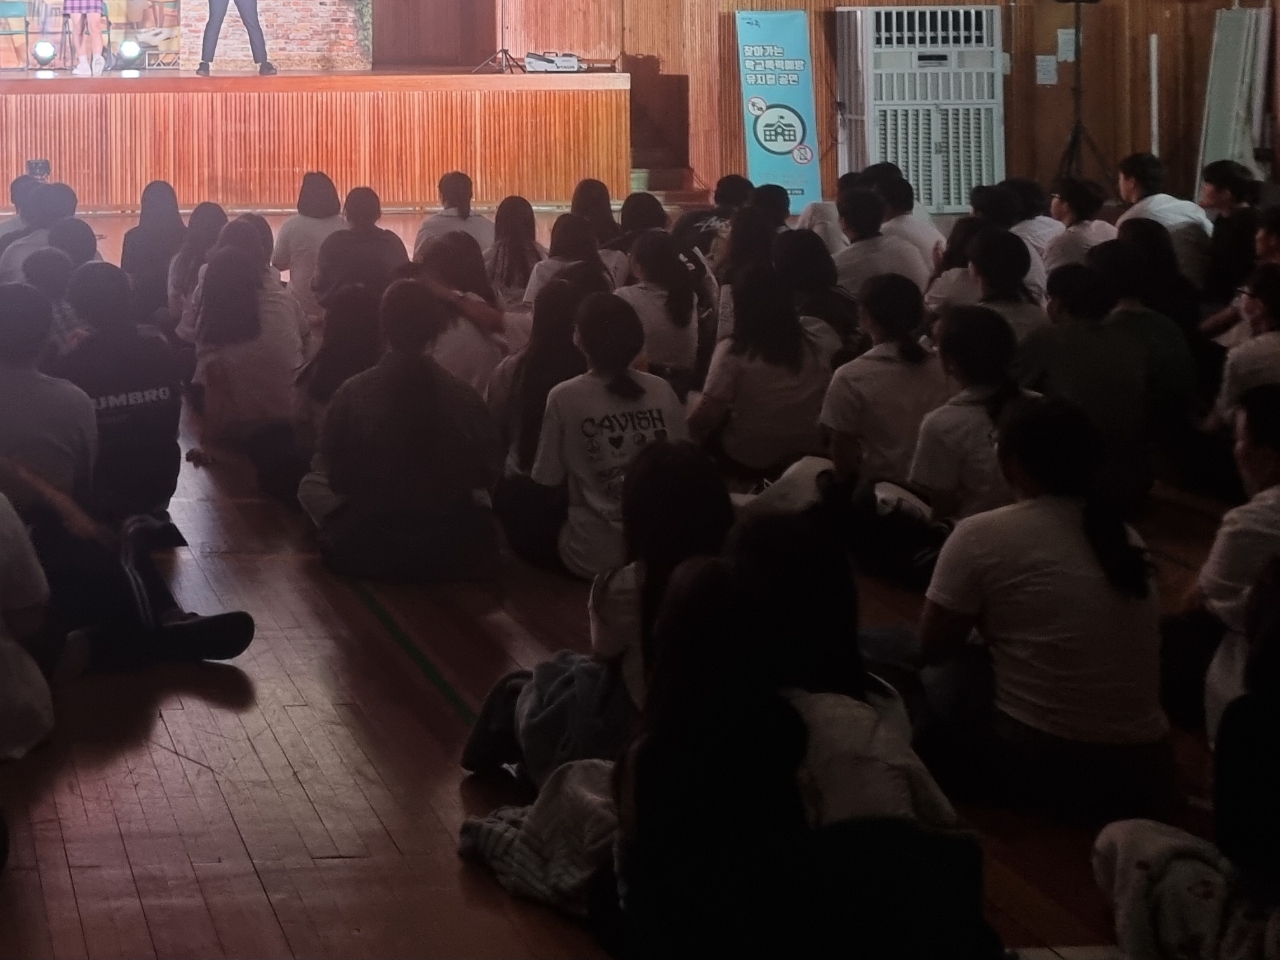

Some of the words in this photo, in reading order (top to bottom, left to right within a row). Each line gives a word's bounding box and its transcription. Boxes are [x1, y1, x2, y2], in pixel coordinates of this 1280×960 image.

[743, 45, 784, 57] 찾아가는
[745, 73, 777, 85] 뮤지컬
[778, 73, 799, 85] 공연
